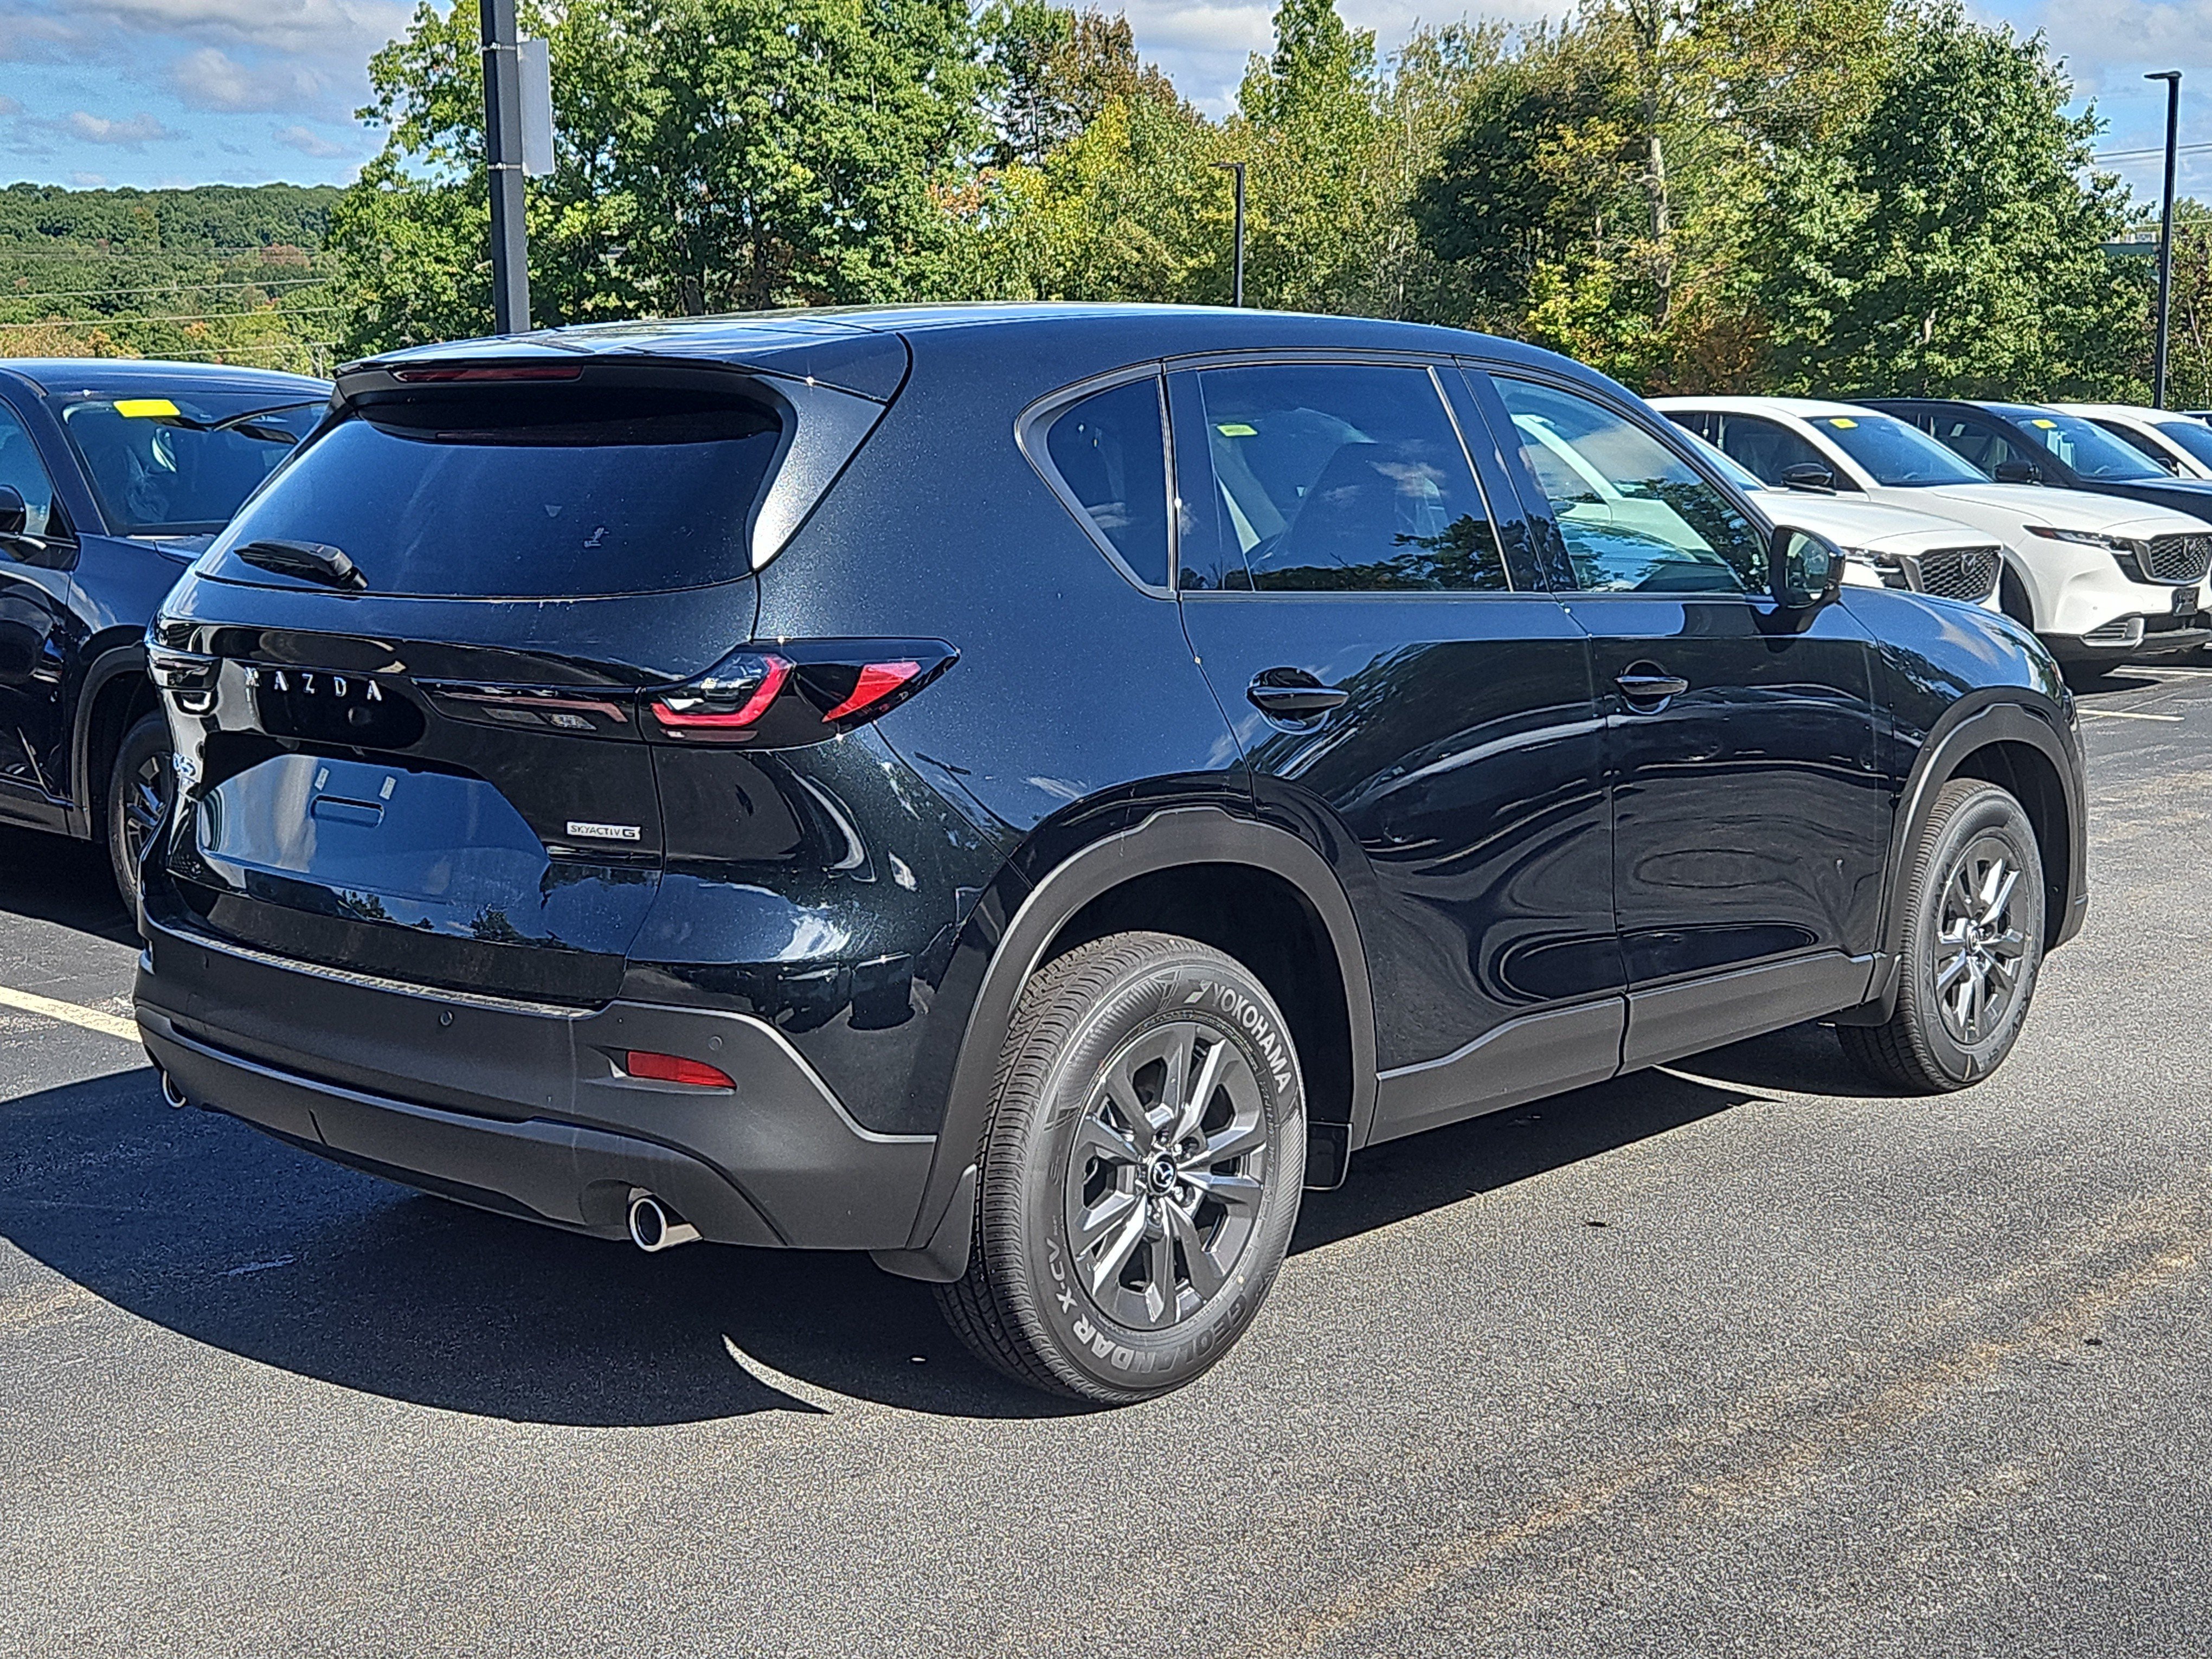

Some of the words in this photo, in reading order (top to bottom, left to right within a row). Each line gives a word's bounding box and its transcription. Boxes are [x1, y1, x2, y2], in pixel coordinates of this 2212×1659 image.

[245, 667, 382, 701] MAZDA
[1212, 982, 1292, 1094] YOKOHAMA
[1046, 1237, 1078, 1314] X-CV
[1072, 1296, 1248, 1373] GEOLANDAR
